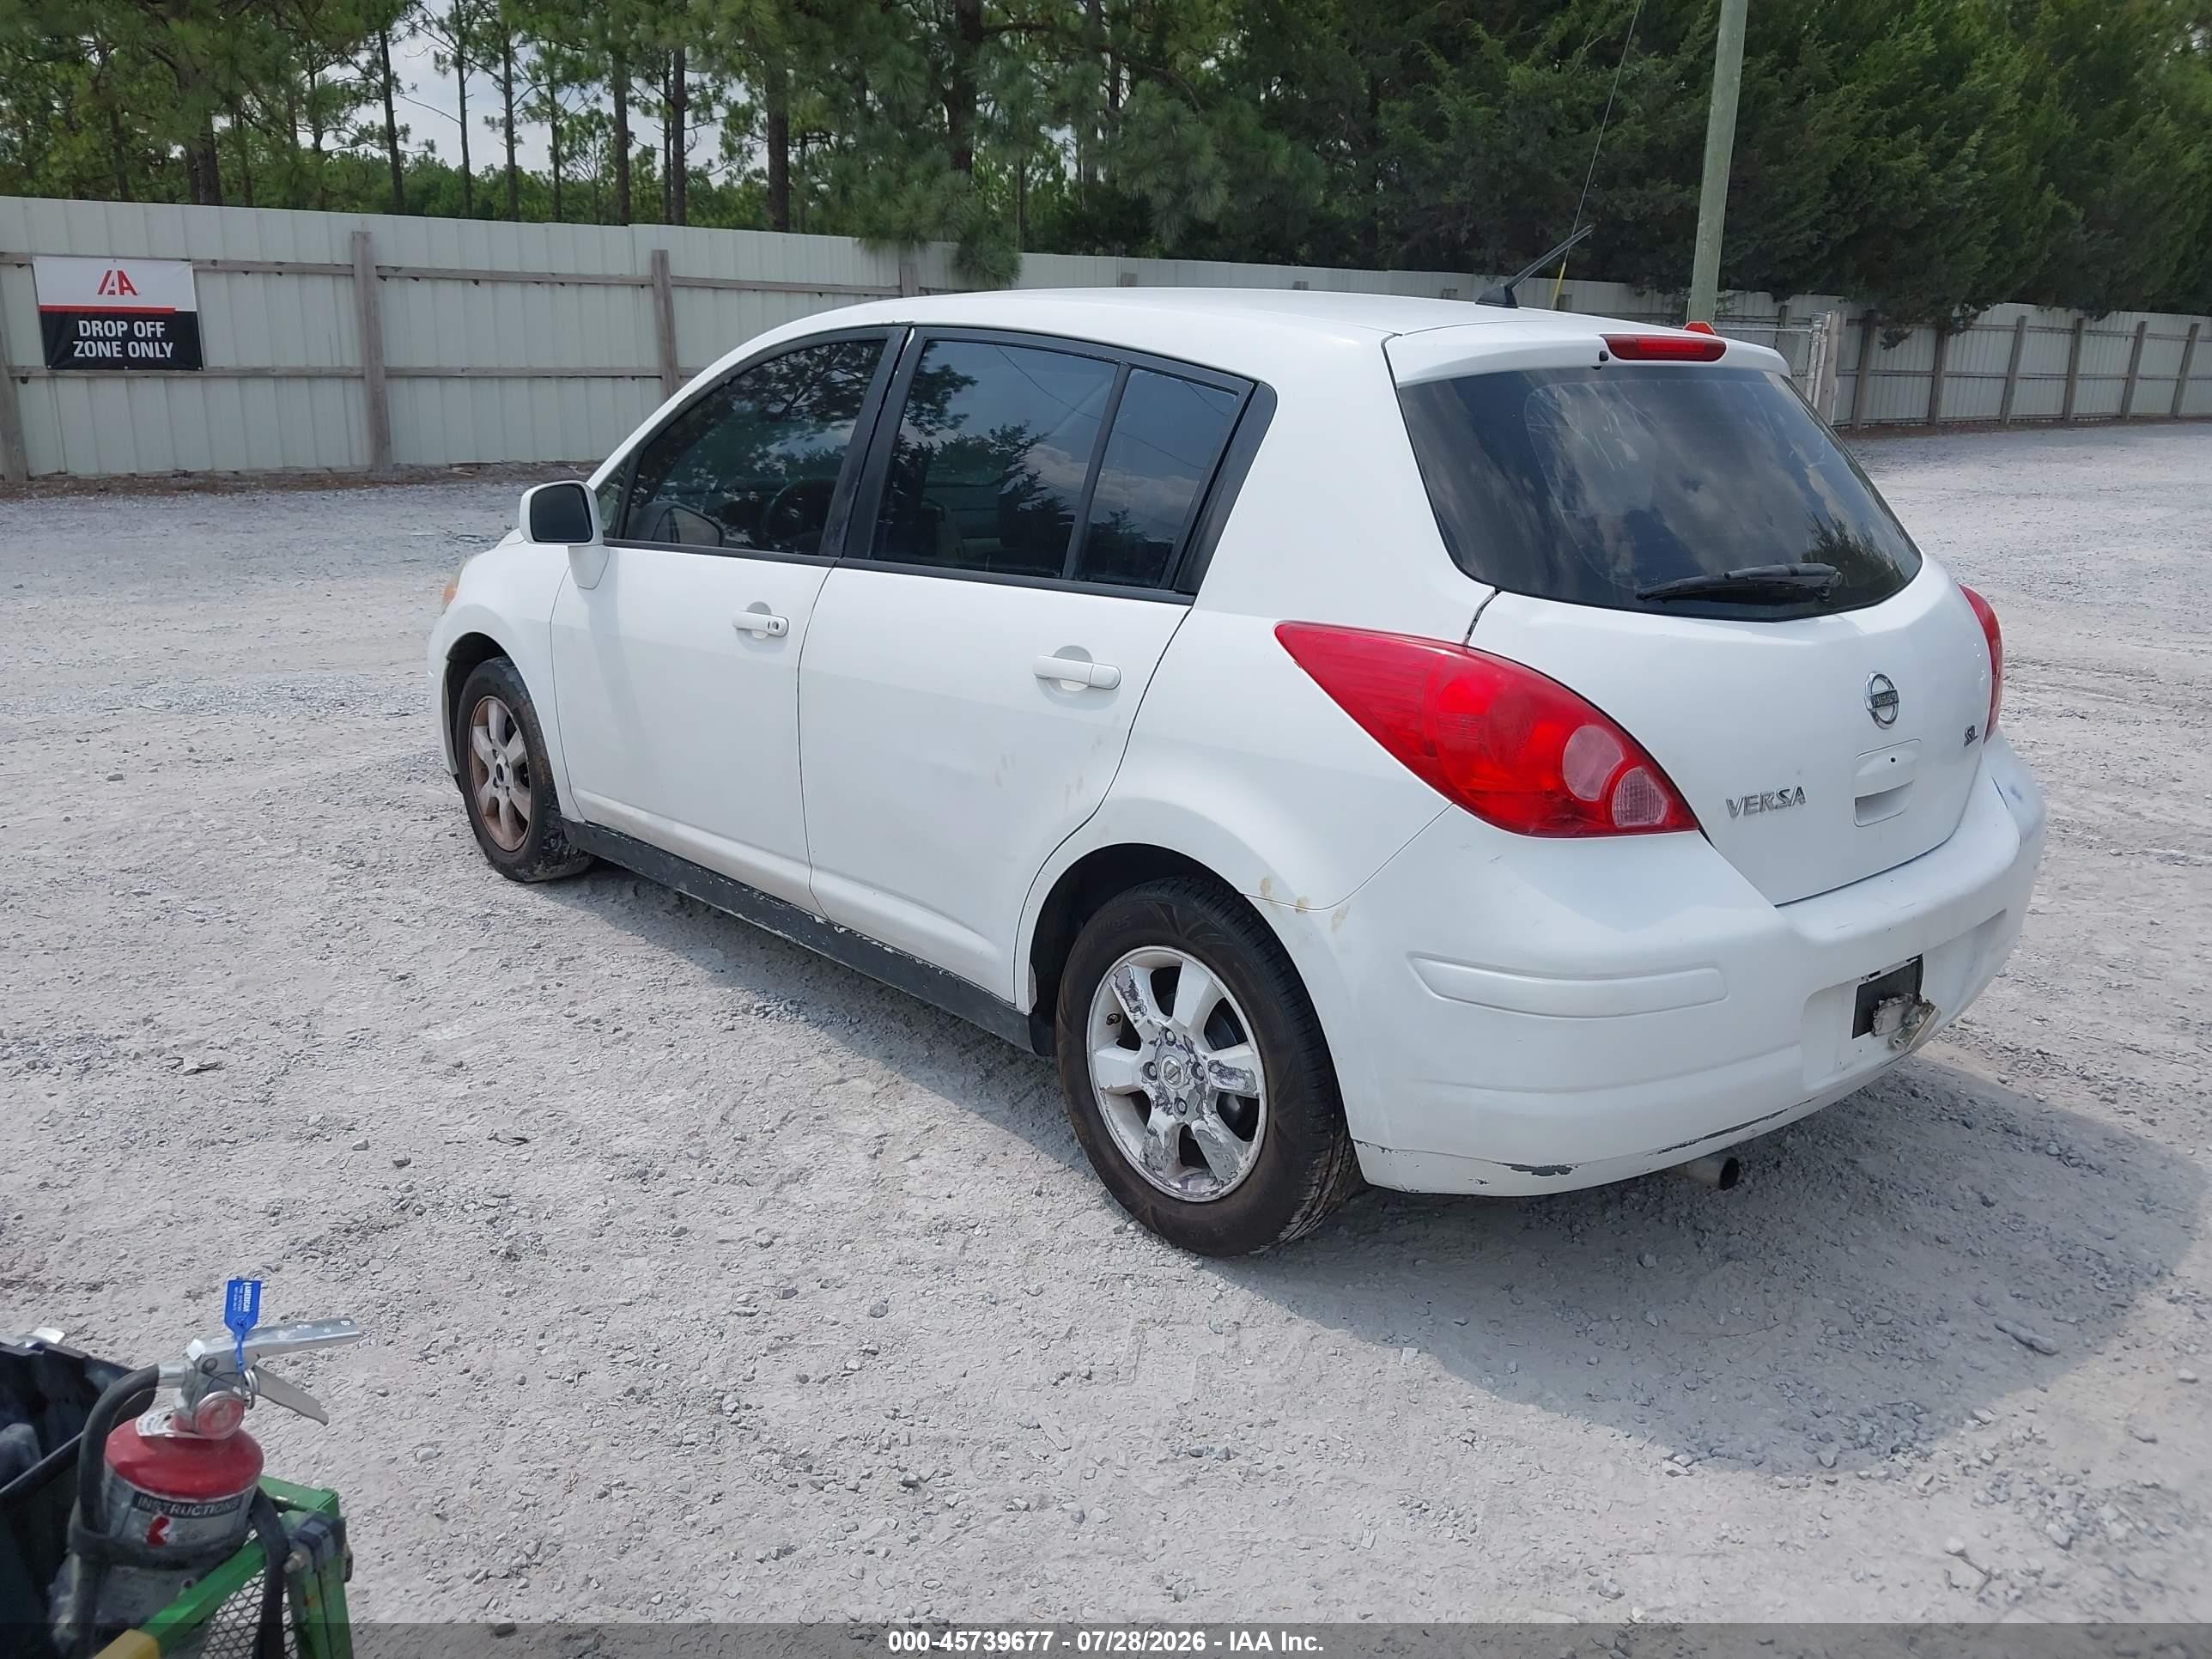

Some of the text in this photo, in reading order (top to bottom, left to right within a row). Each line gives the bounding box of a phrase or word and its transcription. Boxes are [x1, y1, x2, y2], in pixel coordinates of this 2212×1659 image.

[78, 319, 166, 337] DROP OFF
[72, 341, 173, 359] ZONE ONLY
[1725, 785, 1807, 818] VERSA
[242, 1285, 252, 1312] AMERICAN
[137, 1496, 240, 1516] INSTRUCTIONS
